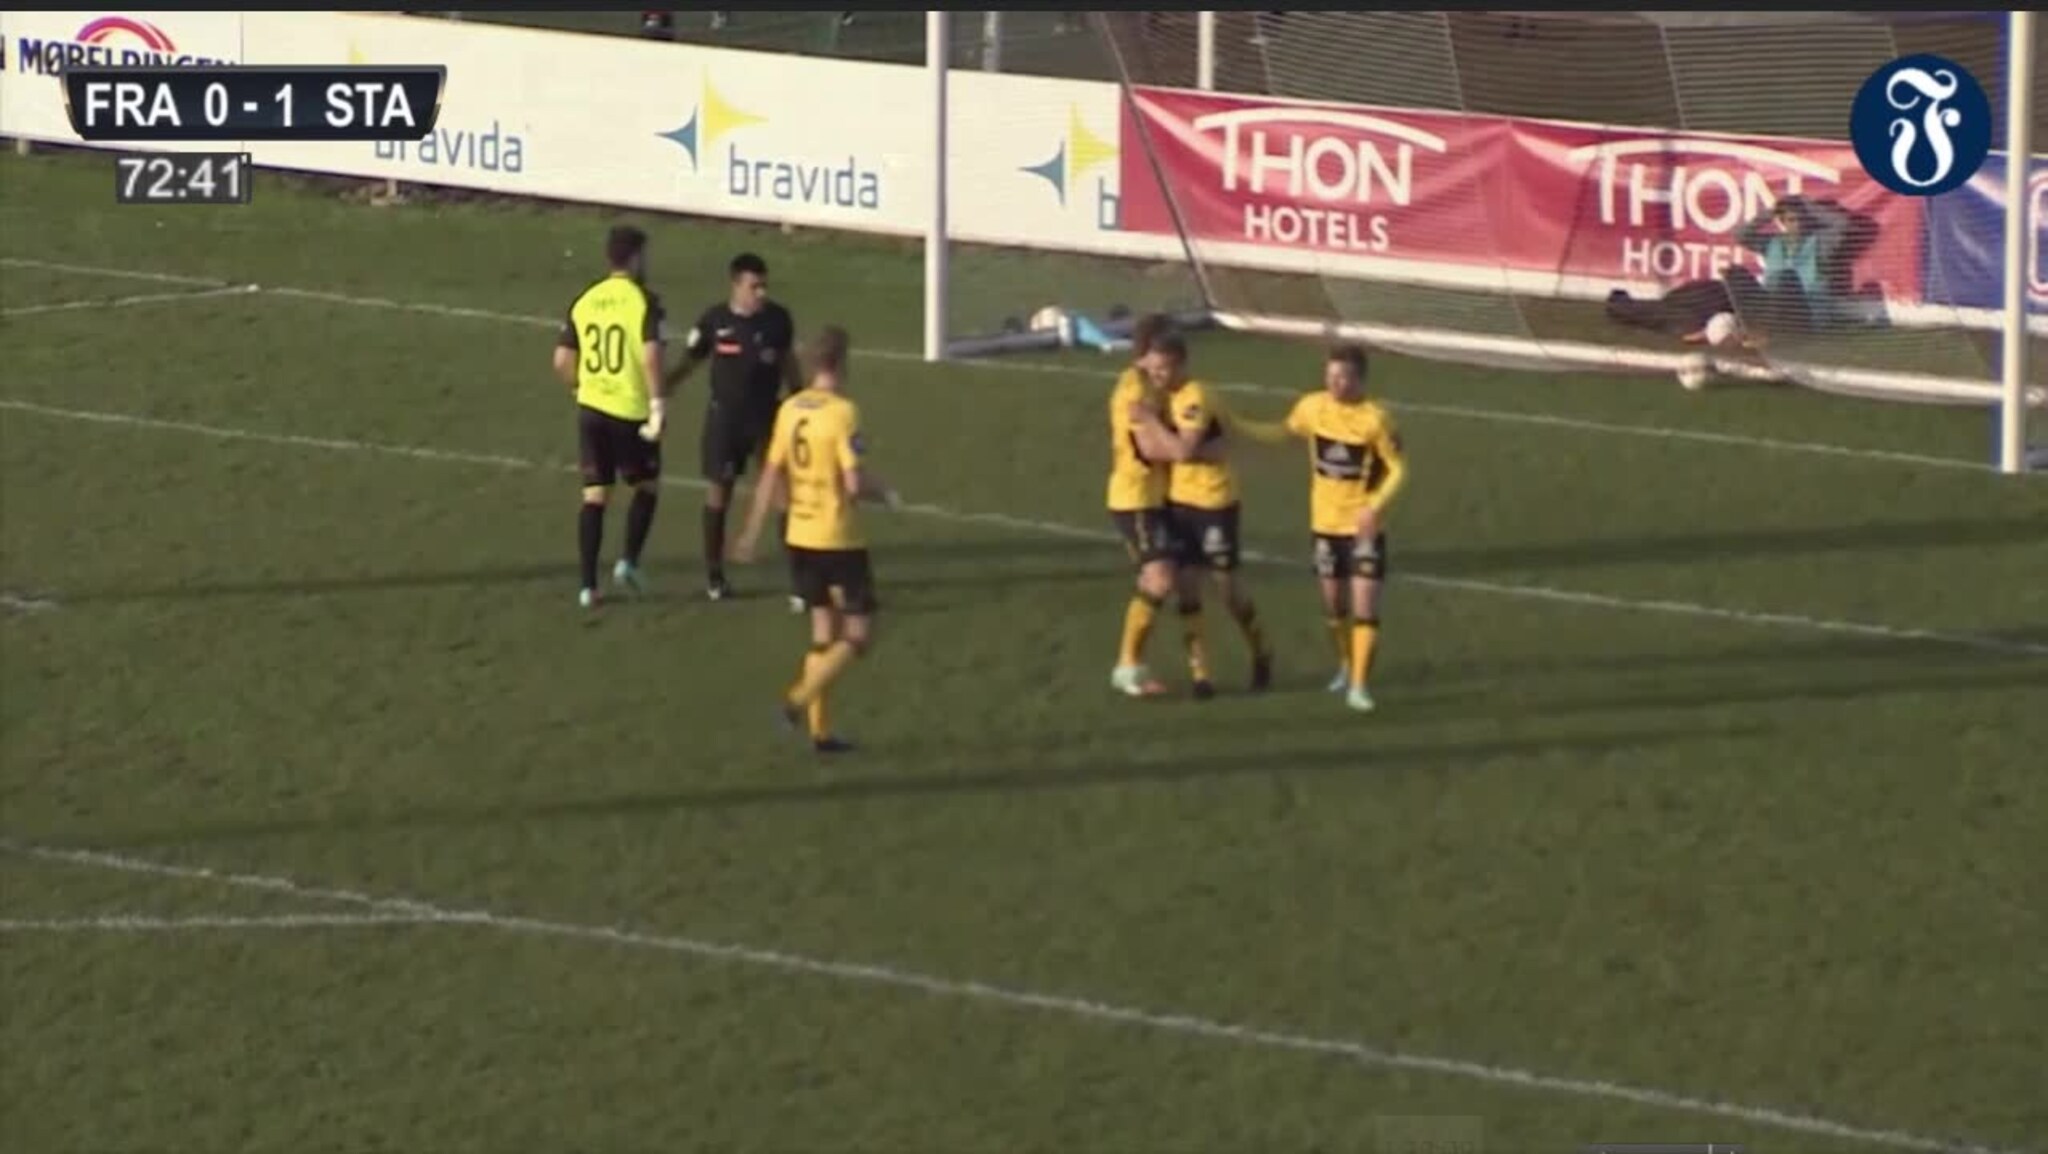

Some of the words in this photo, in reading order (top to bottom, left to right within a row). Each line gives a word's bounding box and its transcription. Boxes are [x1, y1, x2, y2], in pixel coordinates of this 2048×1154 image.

[728, 145, 879, 209] bravida
[1194, 107, 1447, 206] THON
[1244, 204, 1390, 251] HOTELS
[1622, 237, 1768, 287] HOTE
[584, 324, 625, 375] 30
[792, 417, 811, 469] 6
